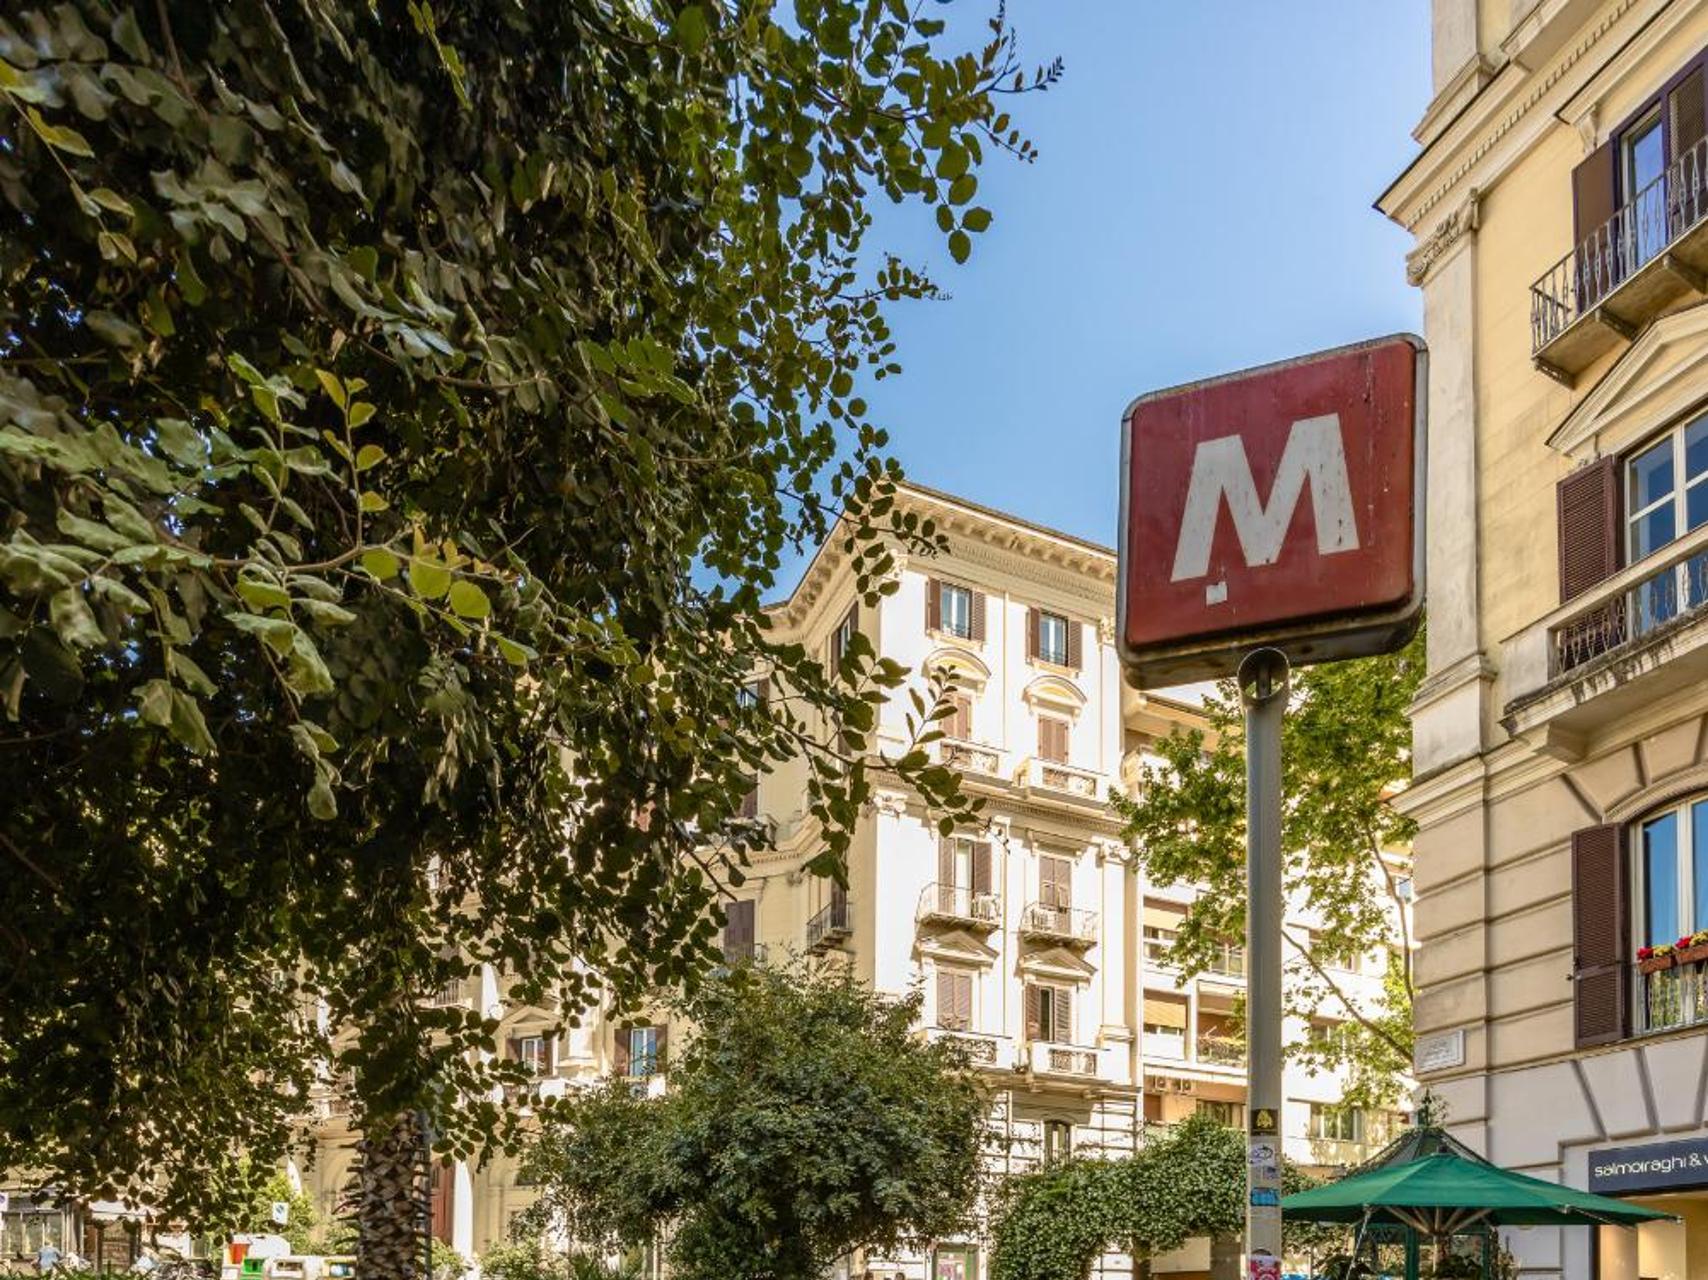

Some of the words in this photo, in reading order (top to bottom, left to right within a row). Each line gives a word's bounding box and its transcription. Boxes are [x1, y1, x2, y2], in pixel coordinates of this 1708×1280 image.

[1170, 413, 1360, 583] M
[1594, 1156, 1687, 1178] salmoiraghi
[1689, 1153, 1702, 1168] &
